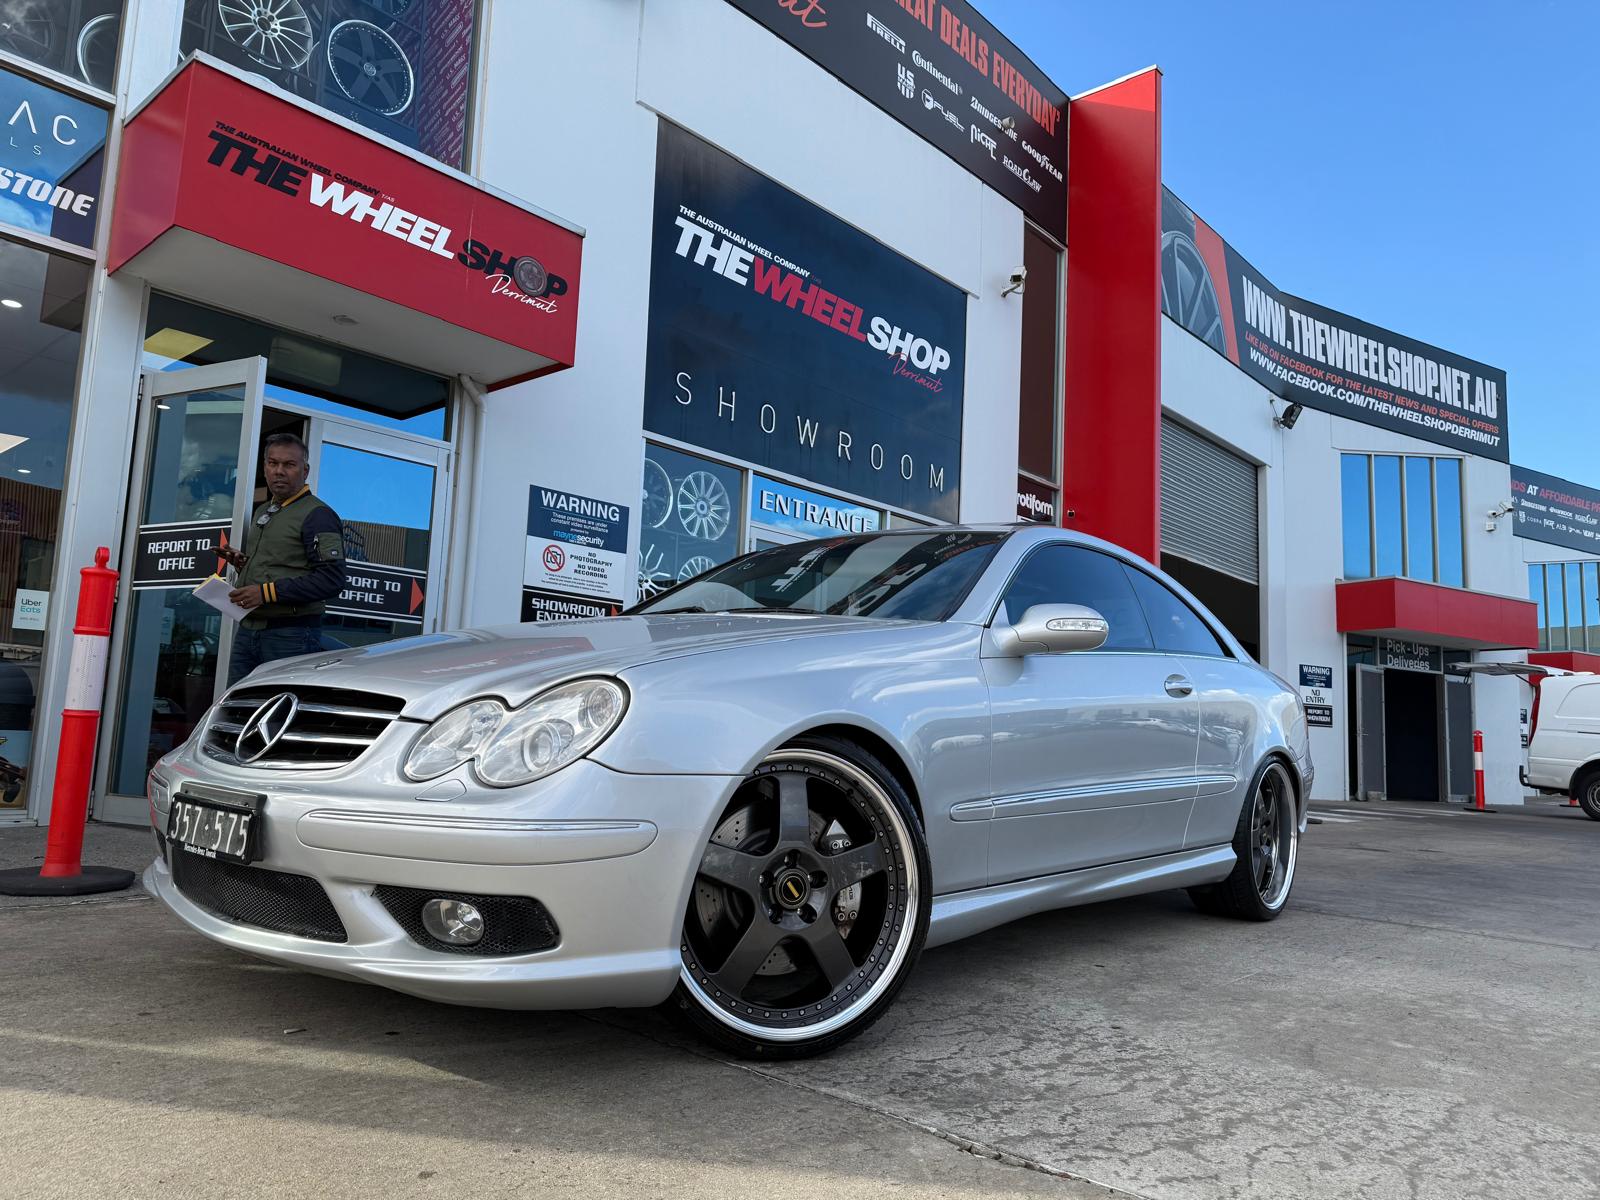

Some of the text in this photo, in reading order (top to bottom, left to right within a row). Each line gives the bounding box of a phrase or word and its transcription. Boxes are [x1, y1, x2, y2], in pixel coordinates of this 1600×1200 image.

[867, 12, 906, 54] PIRELLI
[941, 4, 988, 77] DEALS
[215, 120, 236, 135] THE
[236, 131, 300, 162] AUSTRALIAN
[300, 156, 332, 177] WHEEL
[334, 172, 381, 196] COMPANY
[1022, 140, 1063, 182] GOODYEAR
[208, 129, 309, 198] THE
[309, 172, 455, 260] WHEEL
[679, 204, 811, 278] THE AUSTRALIAN WHEEL COMPANY
[485, 273, 558, 314] Derrimut
[674, 215, 951, 375] THE WHEEL SHOP
[1242, 274, 1498, 419] WWW.THEWHEELSHOP.NET.AU
[888, 352, 943, 393] Derrimut
[1245, 330, 1500, 434] LIKE US ON FACEBOOK FOR THE LATEST NEWS AND SPECIAL OFFERS
[1250, 347, 1501, 447] WWW.FACEBOOK.COM/THEWHEELSHOPDERRIMUT
[675, 372, 945, 493] SHOWROOM
[541, 489, 620, 522] WARNING
[760, 489, 873, 533] ENTRANCE
[1527, 484, 1539, 496] AT
[1540, 488, 1591, 512] AFFORDABLE
[147, 538, 211, 554] REPORT TO
[158, 556, 196, 571] OFFICE
[570, 554, 613, 568] PHOTOGRAPHY
[573, 569, 608, 580] RECORDING
[587, 565, 605, 573] VIDEO
[338, 589, 385, 605] OFFICE
[384, 580, 401, 592] TO
[20, 605, 41, 614] Eats
[21, 598, 42, 607] Uber
[531, 597, 606, 617] SHOWROOM
[1386, 639, 1406, 655] Pick
[1412, 642, 1429, 659] Ups
[1387, 654, 1430, 670] Deliveries
[1302, 665, 1330, 676] WARNING
[1305, 695, 1326, 704] ENTRY
[1311, 689, 1321, 697] NO
